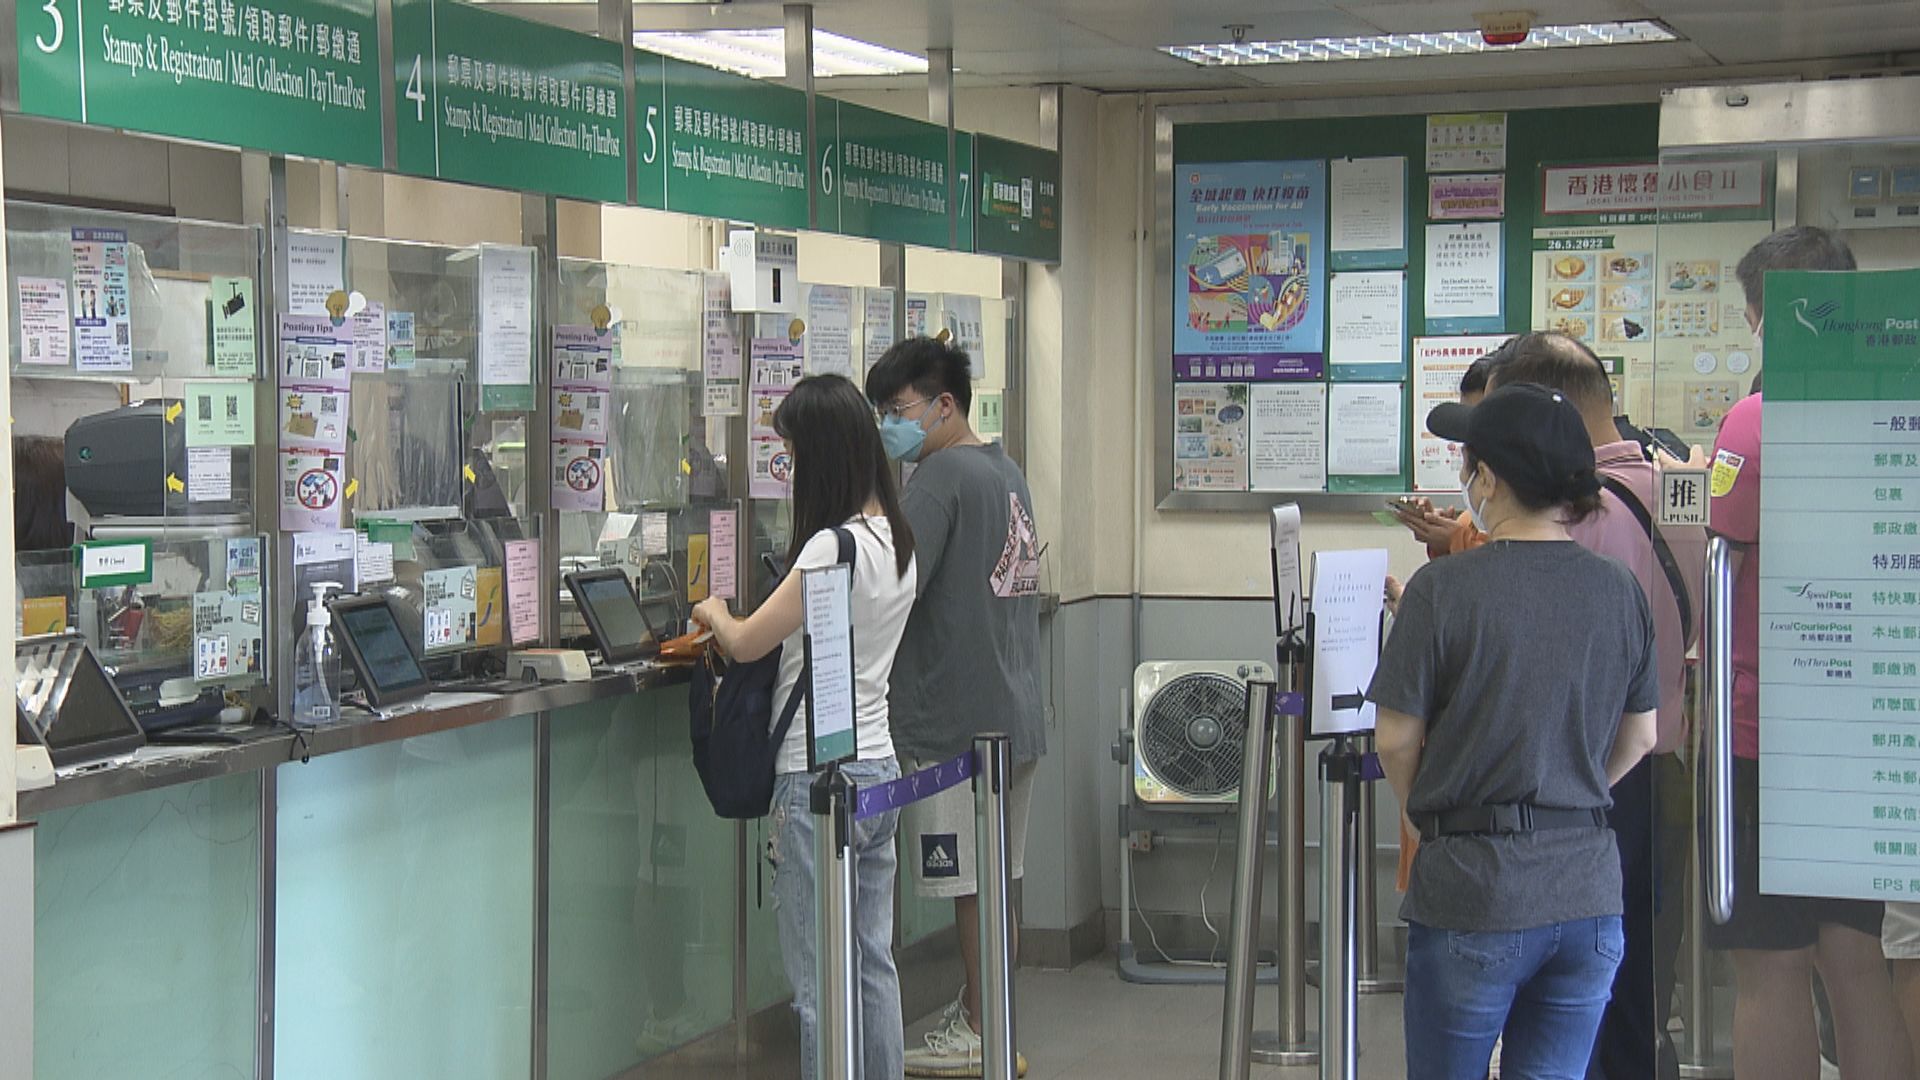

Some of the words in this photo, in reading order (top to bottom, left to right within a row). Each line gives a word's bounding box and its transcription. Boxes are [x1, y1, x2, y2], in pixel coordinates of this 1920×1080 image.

[36, 0, 64, 53] 3
[103, 24, 144, 78] Stamps
[146, 33, 158, 72] &
[160, 36, 223, 85] Registration
[231, 50, 255, 89] Mail
[256, 56, 304, 99] Collection
[310, 68, 366, 111] PayThruPost
[405, 54, 426, 121] 4
[447, 54, 617, 118] 郵票及郵件掛號/領取郵件/郵繳通
[444, 96, 471, 137] Stamps
[472, 102, 481, 133] &
[482, 104, 523, 144] Registration
[529, 111, 545, 144] Mail
[545, 115, 577, 149] Collection
[581, 123, 620, 160] PayThruPost
[643, 106, 657, 163] 5
[672, 140, 693, 177] Stamps
[693, 145, 699, 172] &
[700, 146, 731, 180] Registration
[735, 152, 747, 180] Mail
[748, 154, 772, 183] Collection
[821, 144, 833, 195] 6
[959, 172, 969, 217] 7
[1190, 187, 1247, 204] 全城起動
[1252, 185, 1310, 201] 快打疫苗
[1196, 204, 1219, 213] Early
[1221, 203, 1273, 211] Vaccination
[1290, 201, 1304, 209] All
[1639, 212, 1671, 222] SPECAL
[1673, 211, 1703, 221] STAMPS
[283, 322, 315, 333] Posting
[317, 324, 333, 334] Tips
[556, 332, 581, 343] Posting
[581, 332, 598, 342] Tips
[1866, 334, 1917, 347] 香港郵政
[1874, 453, 1918, 467] 郵票及
[1670, 479, 1697, 508] 推
[1875, 488, 1903, 501] 包裹
[1669, 513, 1699, 523] PUSH
[1873, 522, 1920, 535] 郵政繳
[1872, 591, 1920, 606] 特快專
[1872, 626, 1920, 640] 本地郵
[1872, 661, 1917, 676] 郵繳通
[1872, 697, 1920, 712] 西聯匯
[1872, 734, 1920, 747] 郵用產
[1872, 770, 1920, 785] 本地郵
[1873, 805, 1920, 821] 郵政信
[1873, 840, 1920, 857] 報關服
[1873, 878, 1903, 891] EPS
